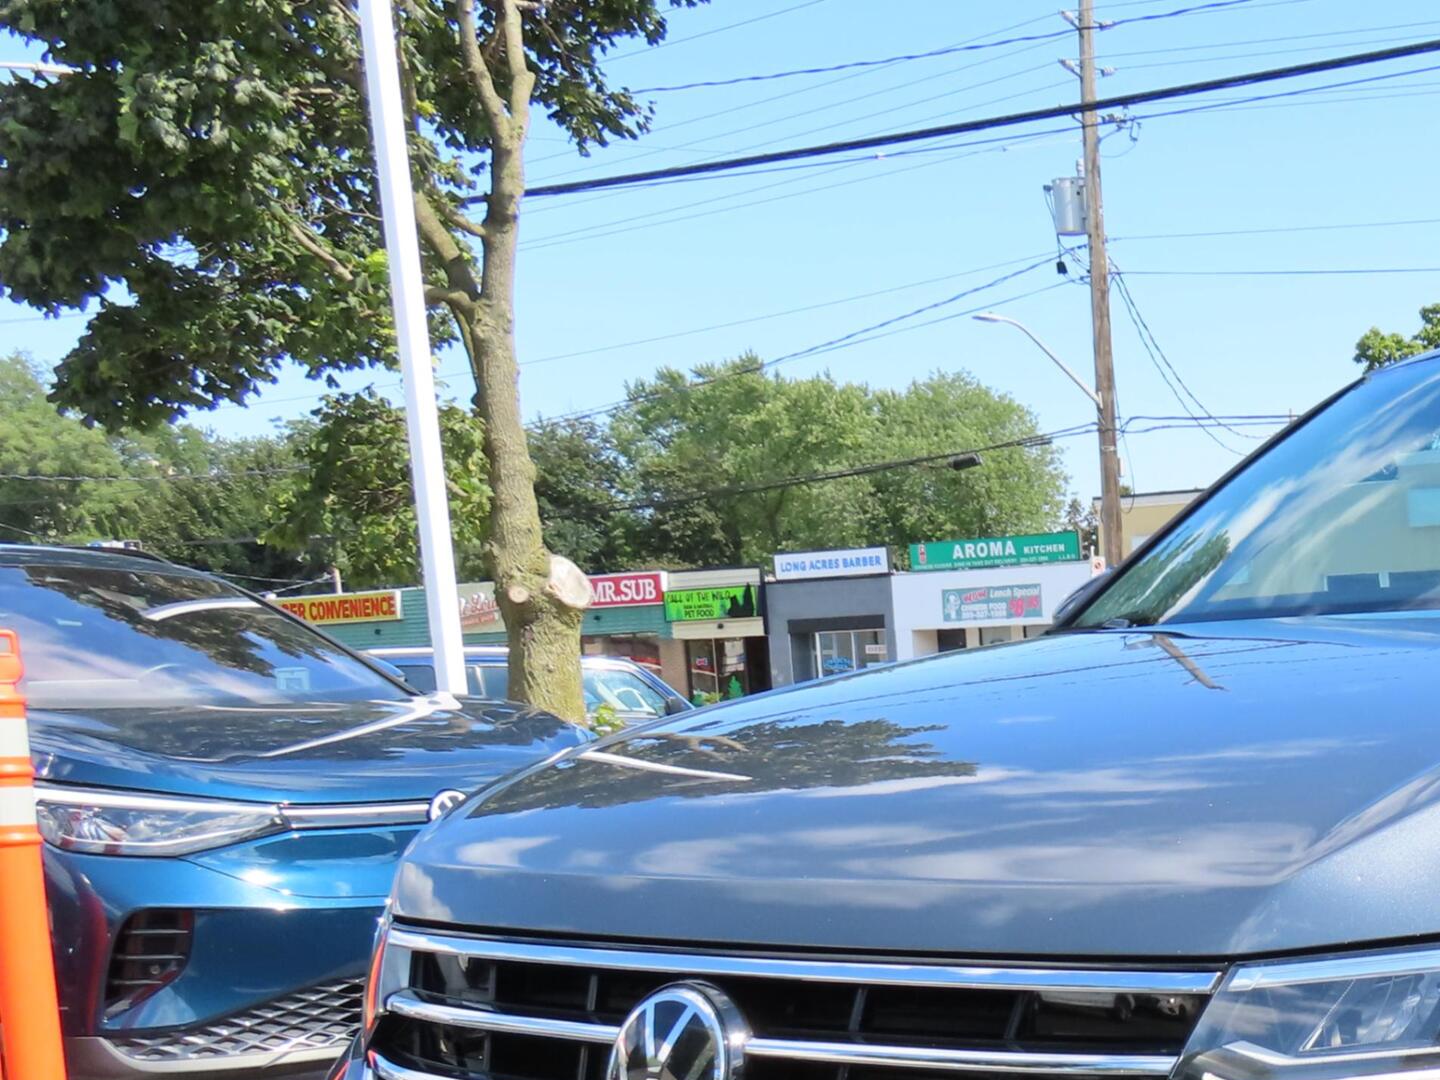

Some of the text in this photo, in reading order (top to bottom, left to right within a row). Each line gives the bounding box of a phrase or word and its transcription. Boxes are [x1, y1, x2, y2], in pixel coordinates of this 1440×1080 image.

[952, 541, 1016, 559] AROMA
[1023, 543, 1065, 554] KITCHEN
[780, 555, 882, 573] LONG ACRES BARBER
[592, 578, 657, 603] MR.SUB
[309, 596, 396, 620] CONVENIENCE
[697, 609, 714, 617] FOOD
